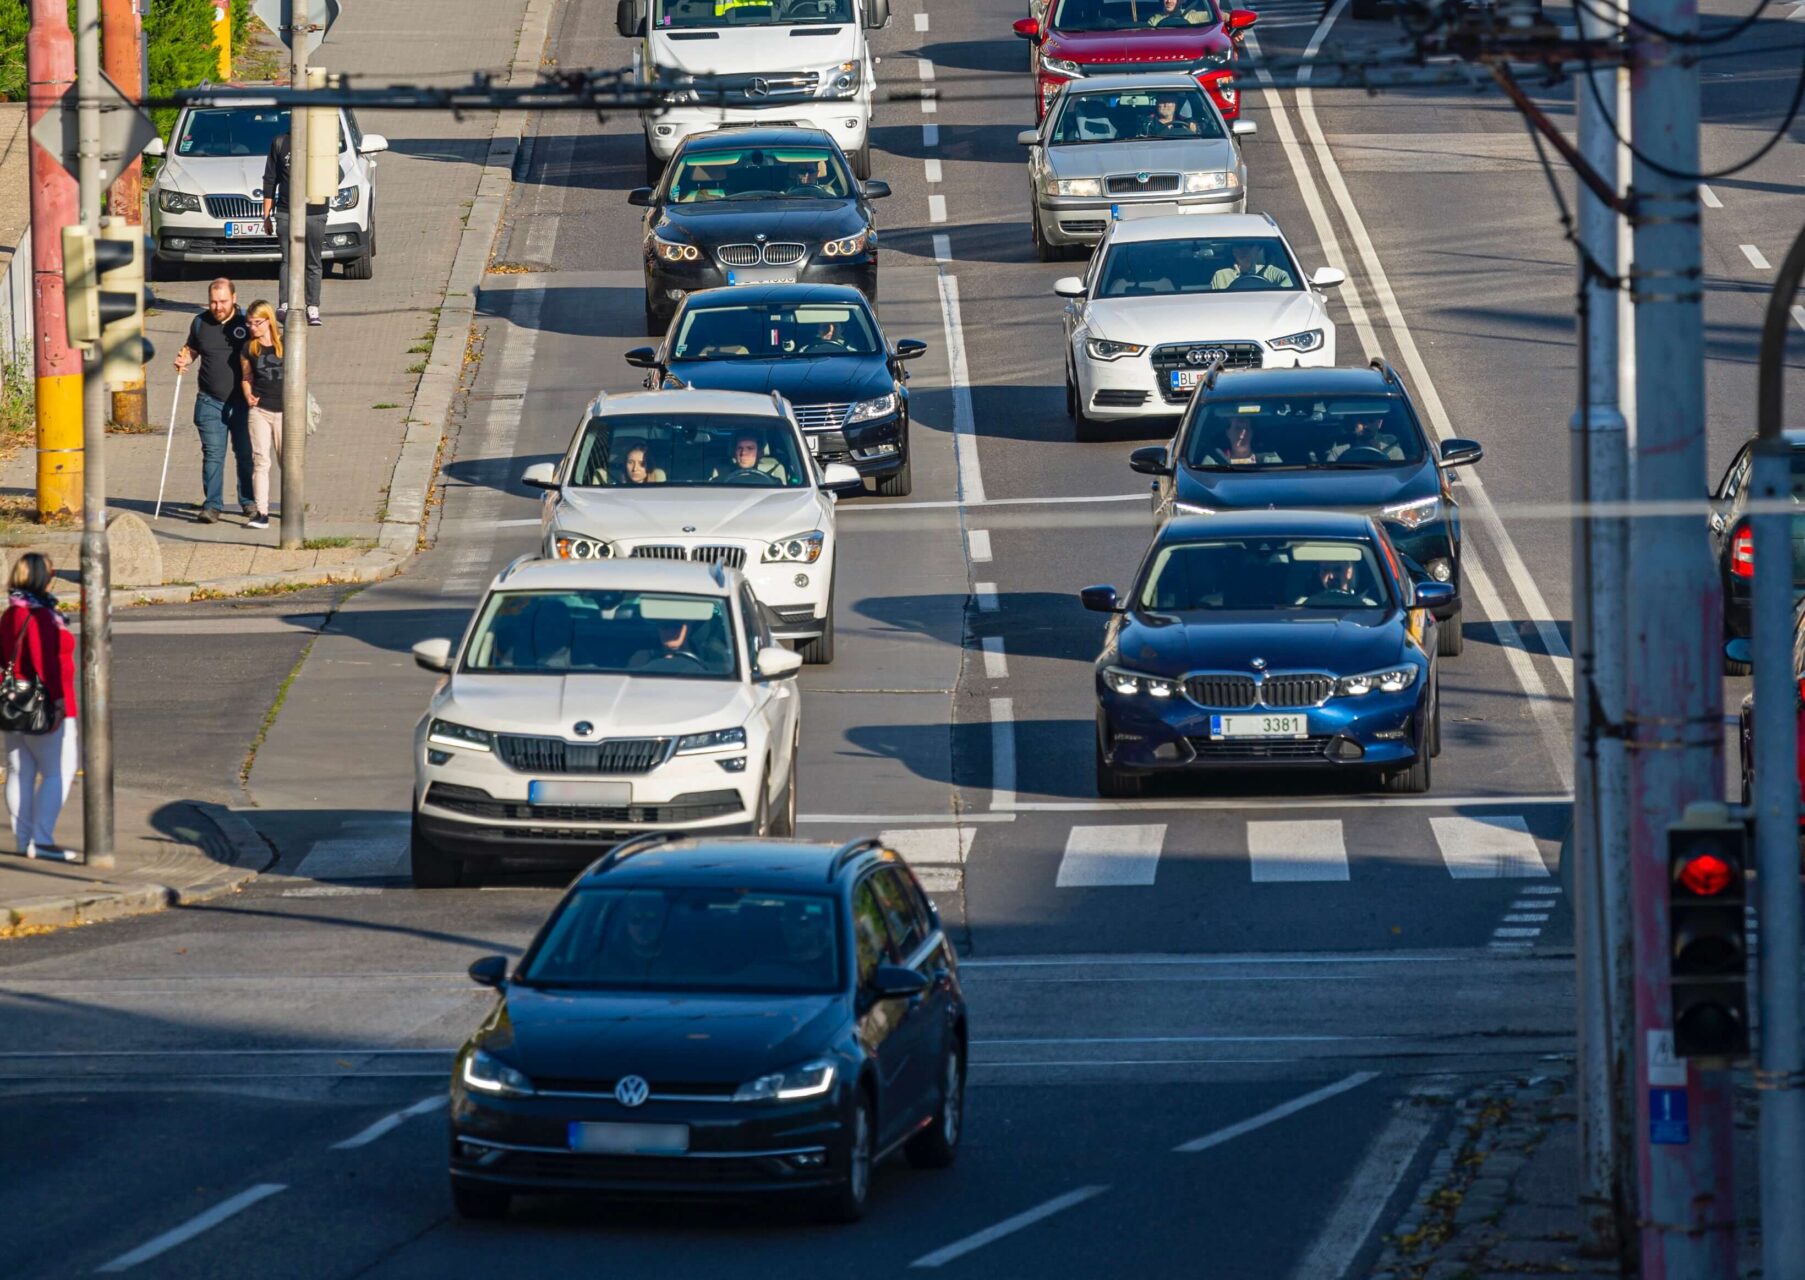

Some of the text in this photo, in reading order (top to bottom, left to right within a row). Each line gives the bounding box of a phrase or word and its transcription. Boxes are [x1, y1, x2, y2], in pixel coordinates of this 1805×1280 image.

[233, 223, 246, 235] BL
[1179, 372, 1196, 385] BL
[1224, 717, 1233, 733] T
[1263, 717, 1299, 733] 3381
